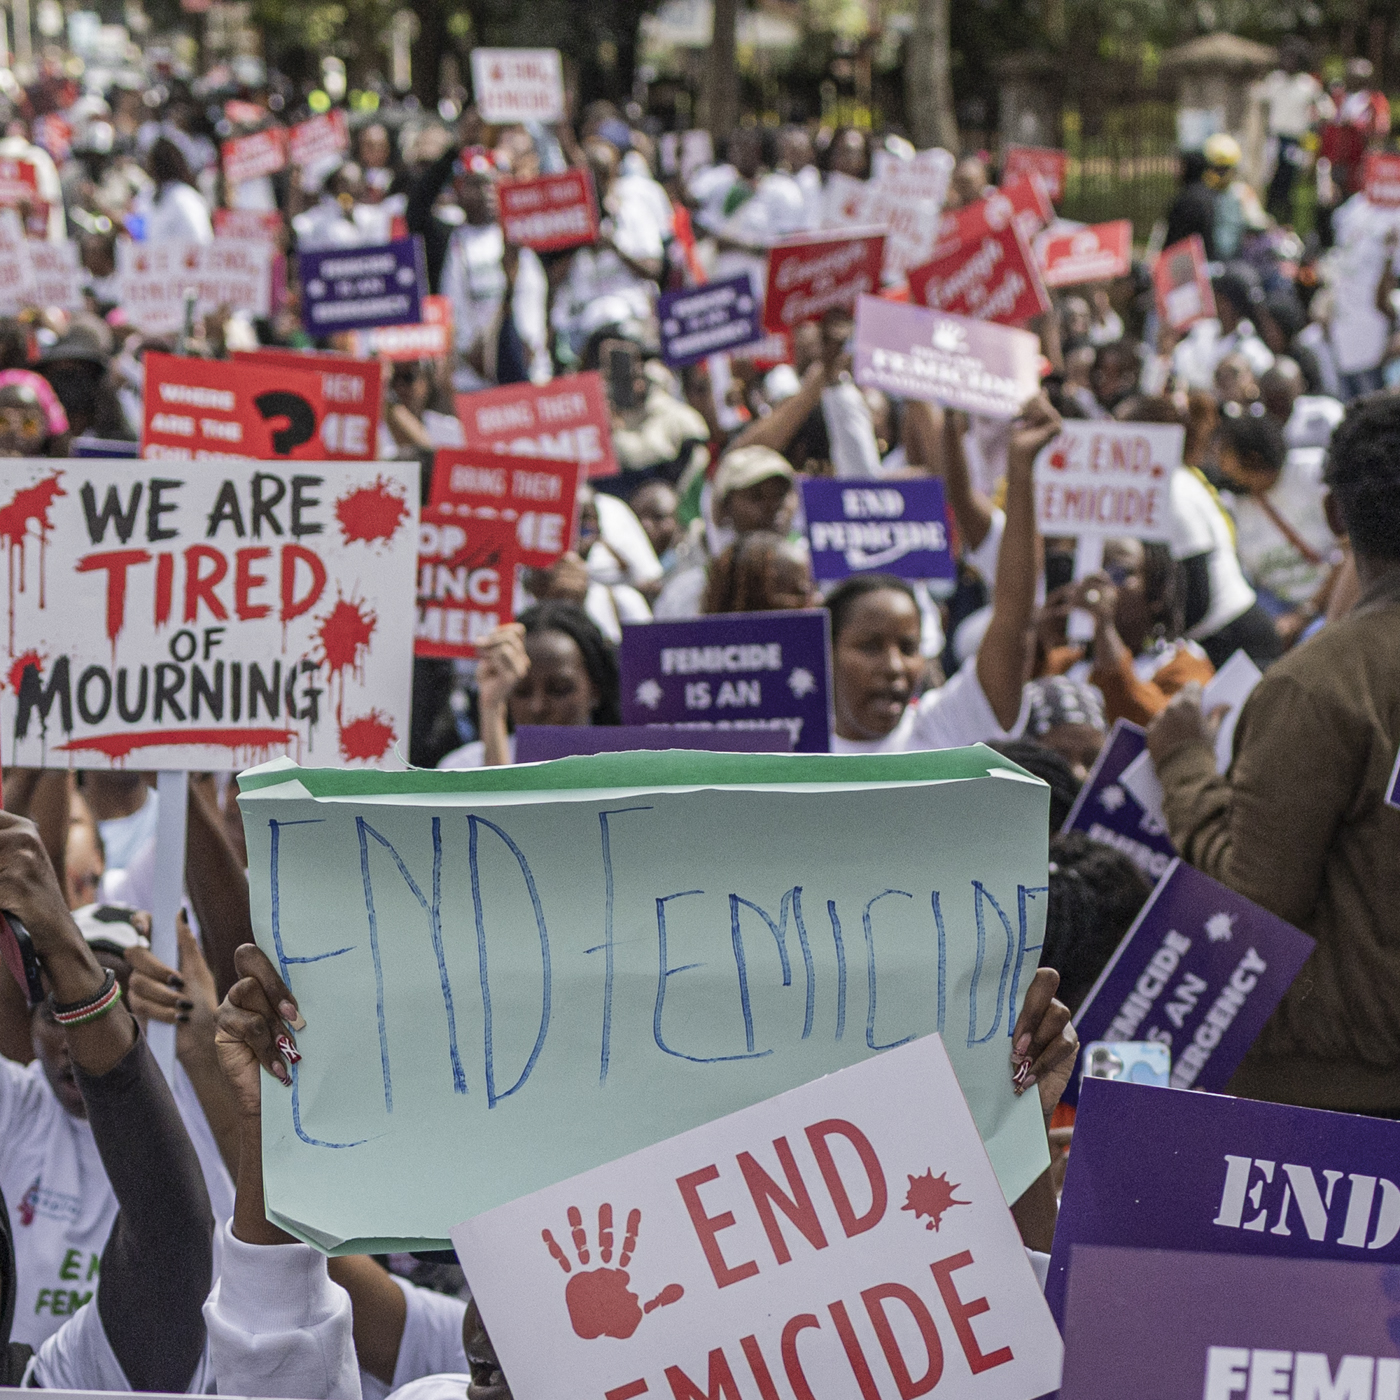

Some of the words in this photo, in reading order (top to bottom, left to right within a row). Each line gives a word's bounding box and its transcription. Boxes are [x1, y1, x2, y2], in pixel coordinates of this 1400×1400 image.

[158, 381, 236, 412] WHERE
[150, 413, 198, 438] ARE
[202, 416, 242, 444] THE
[1088, 433, 1154, 477] END
[80, 478, 186, 544] WE
[206, 473, 325, 538] ARE
[75, 543, 328, 642] TIRED
[169, 626, 226, 662] OF
[663, 643, 783, 677] FEMICIDE
[14, 655, 325, 740] MOURNING
[684, 681, 715, 708] IS
[717, 679, 762, 708] AN
[268, 813, 552, 1149] END
[585, 806, 1050, 1086] FEMICIDE
[1103, 928, 1192, 1042] EMICIDE
[675, 1117, 890, 1290] END
